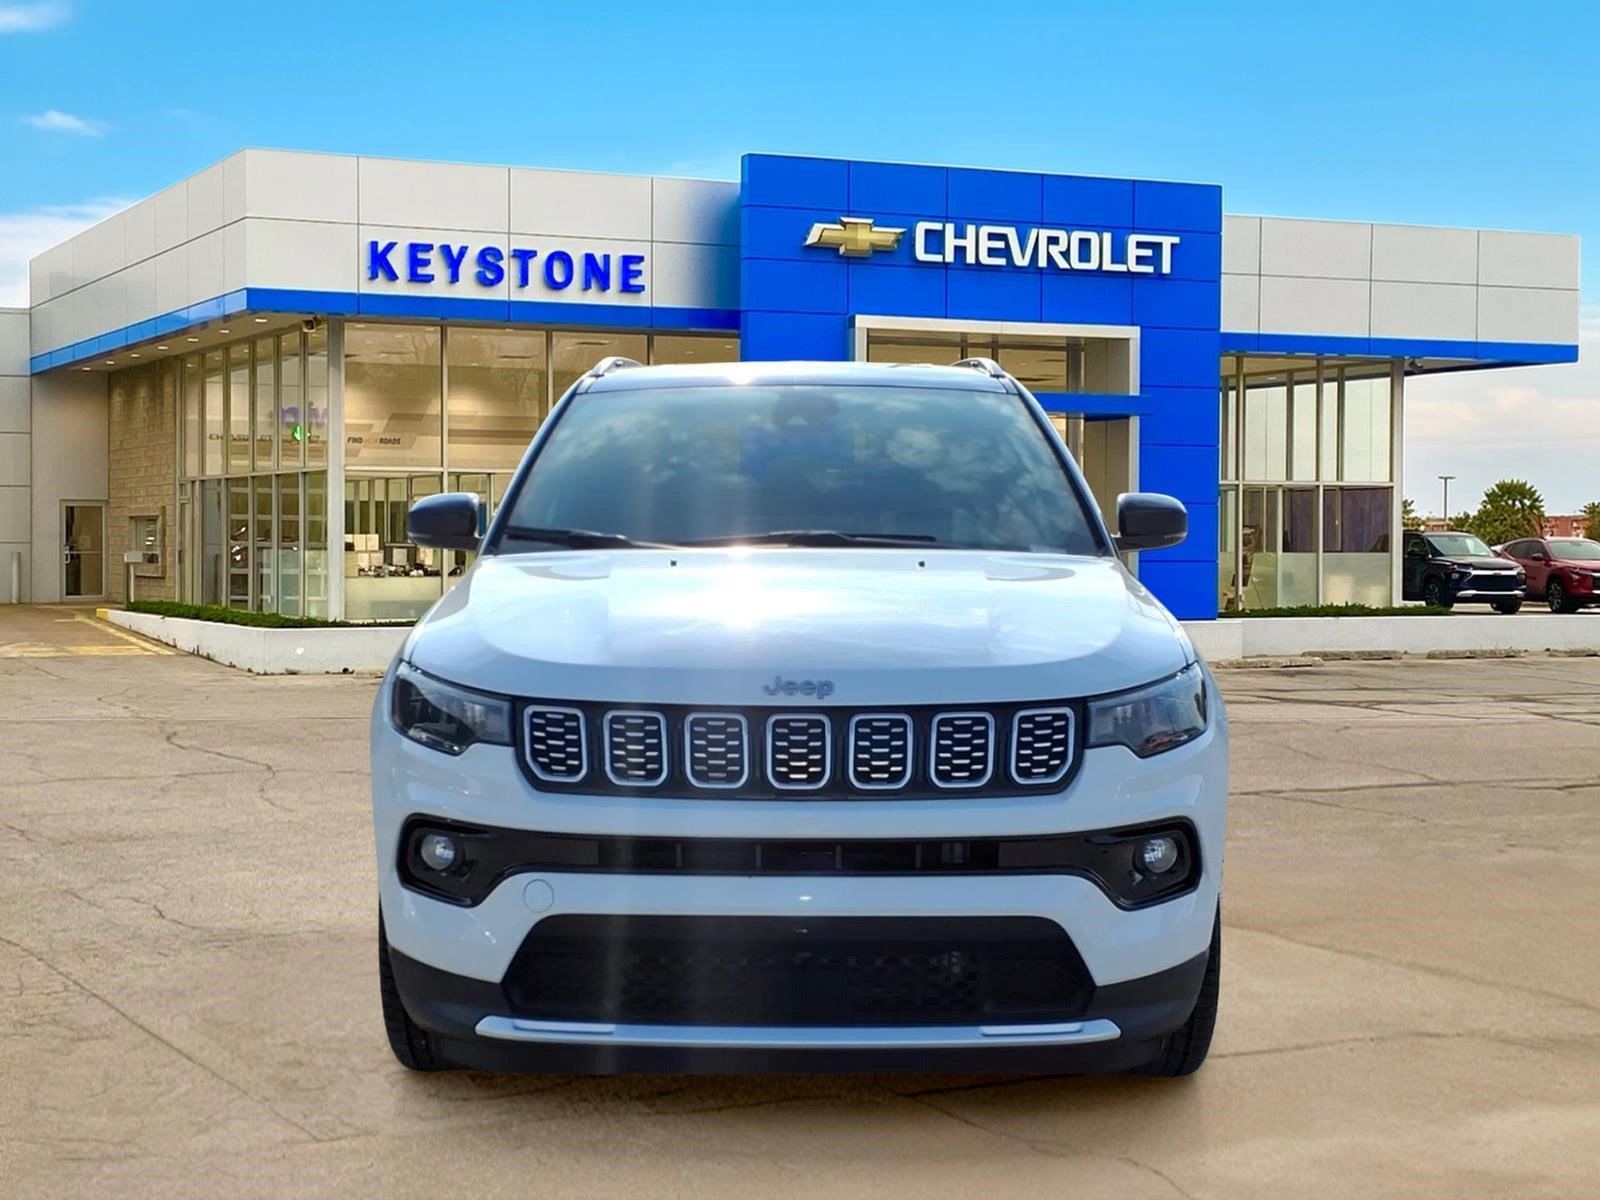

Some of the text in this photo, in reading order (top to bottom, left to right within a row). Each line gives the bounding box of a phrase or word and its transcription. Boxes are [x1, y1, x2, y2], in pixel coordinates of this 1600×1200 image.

[368, 240, 646, 294] KEYSTONE
[914, 221, 1180, 275] CHEVROLET
[763, 675, 834, 700] Jeep
